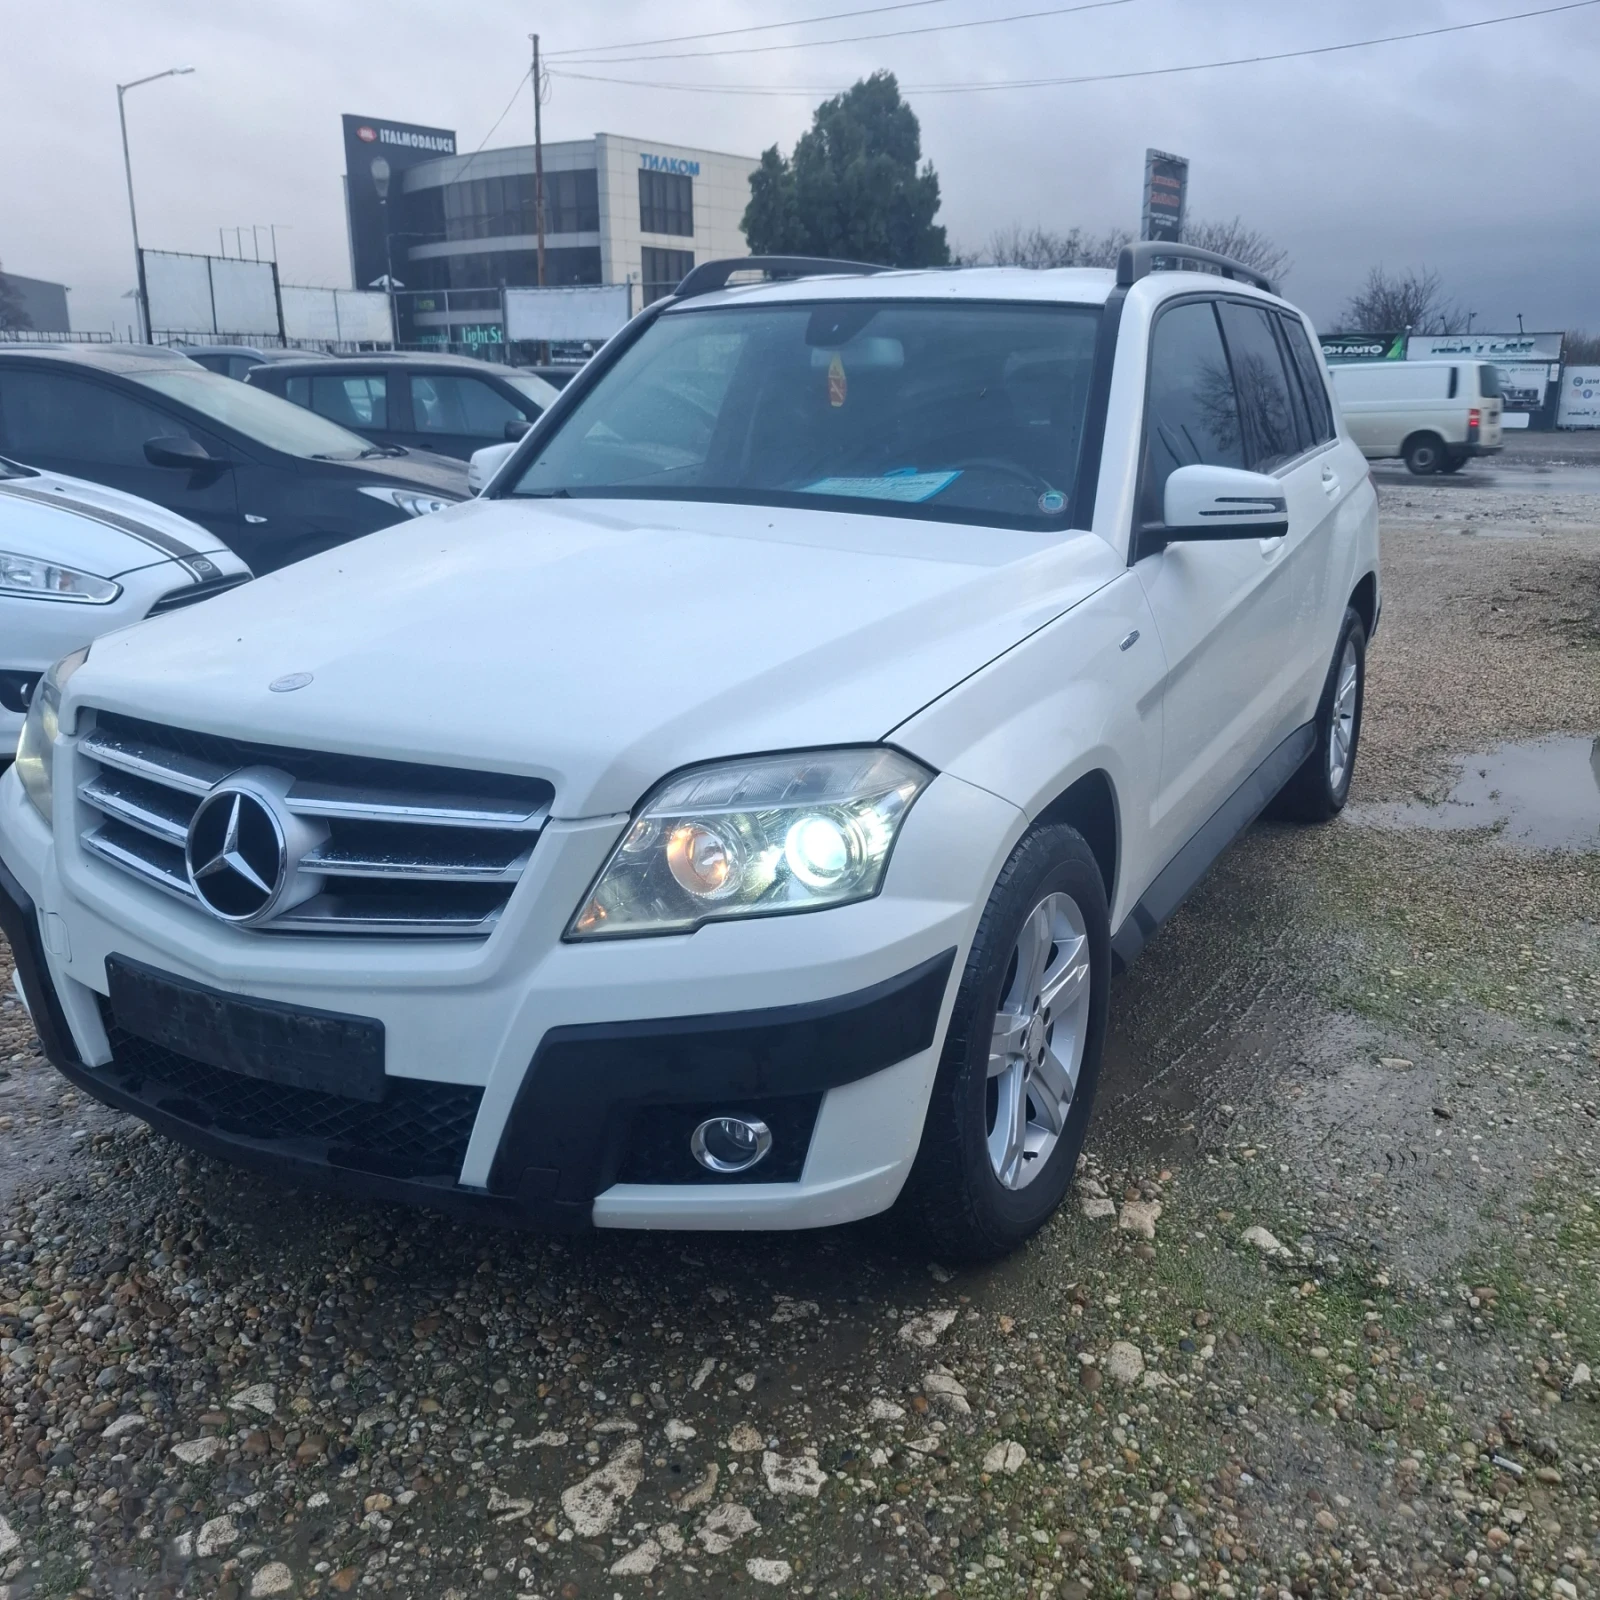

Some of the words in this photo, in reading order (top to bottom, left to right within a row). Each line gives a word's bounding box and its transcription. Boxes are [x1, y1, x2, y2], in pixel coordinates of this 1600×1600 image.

[380, 128, 454, 153] ITALMODALUCE
[640, 153, 700, 176] ТИЛКОМ
[462, 325, 489, 351] Light
[490, 326, 503, 344] St
[1321, 345, 1343, 355] ОН
